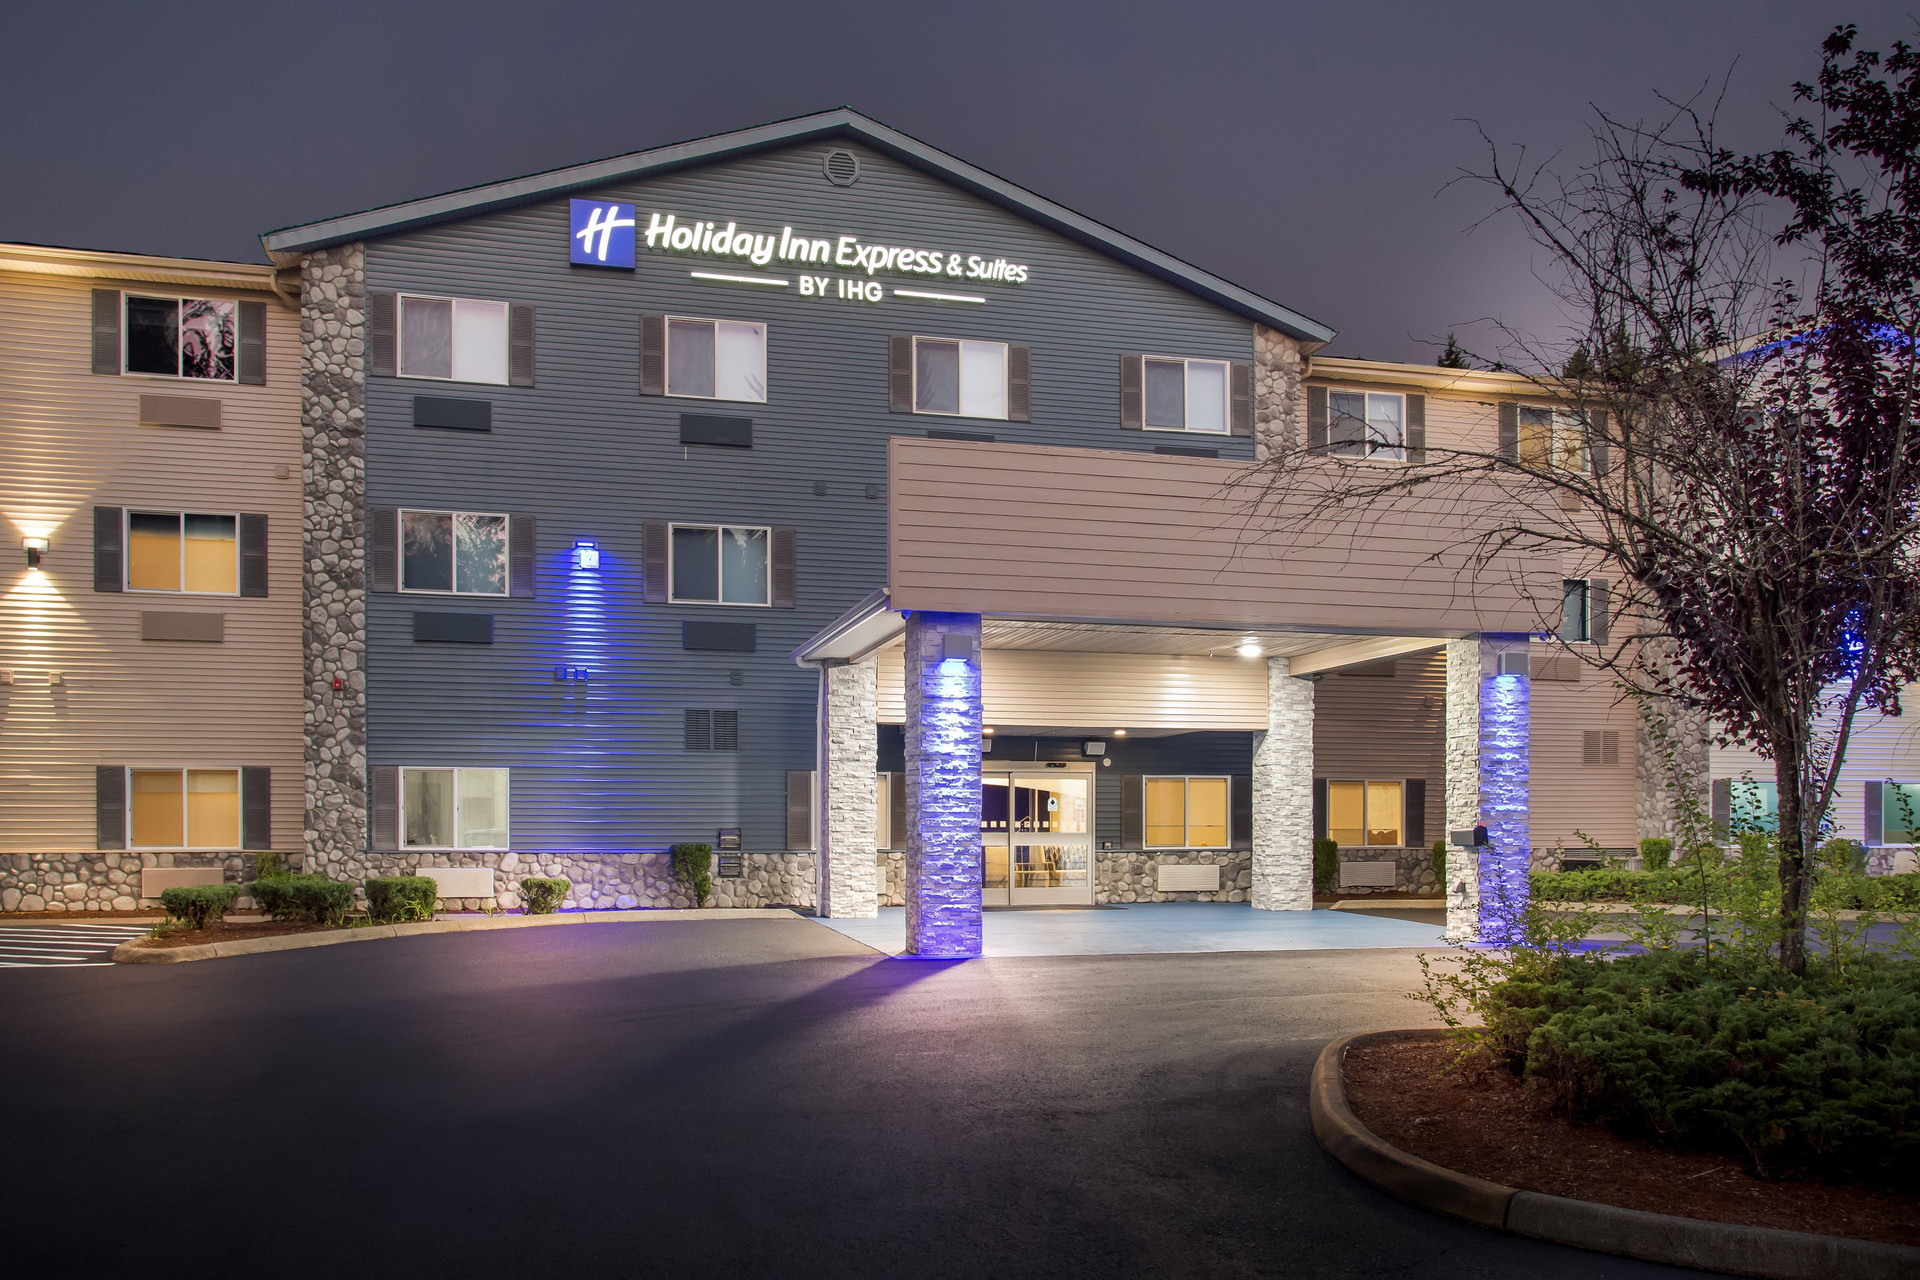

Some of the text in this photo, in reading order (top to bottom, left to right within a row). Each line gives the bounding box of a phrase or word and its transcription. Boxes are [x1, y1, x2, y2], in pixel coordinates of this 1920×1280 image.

[644, 213, 1029, 283] Holiday Inn Express & Suites
[799, 275, 884, 303] BY IHG
